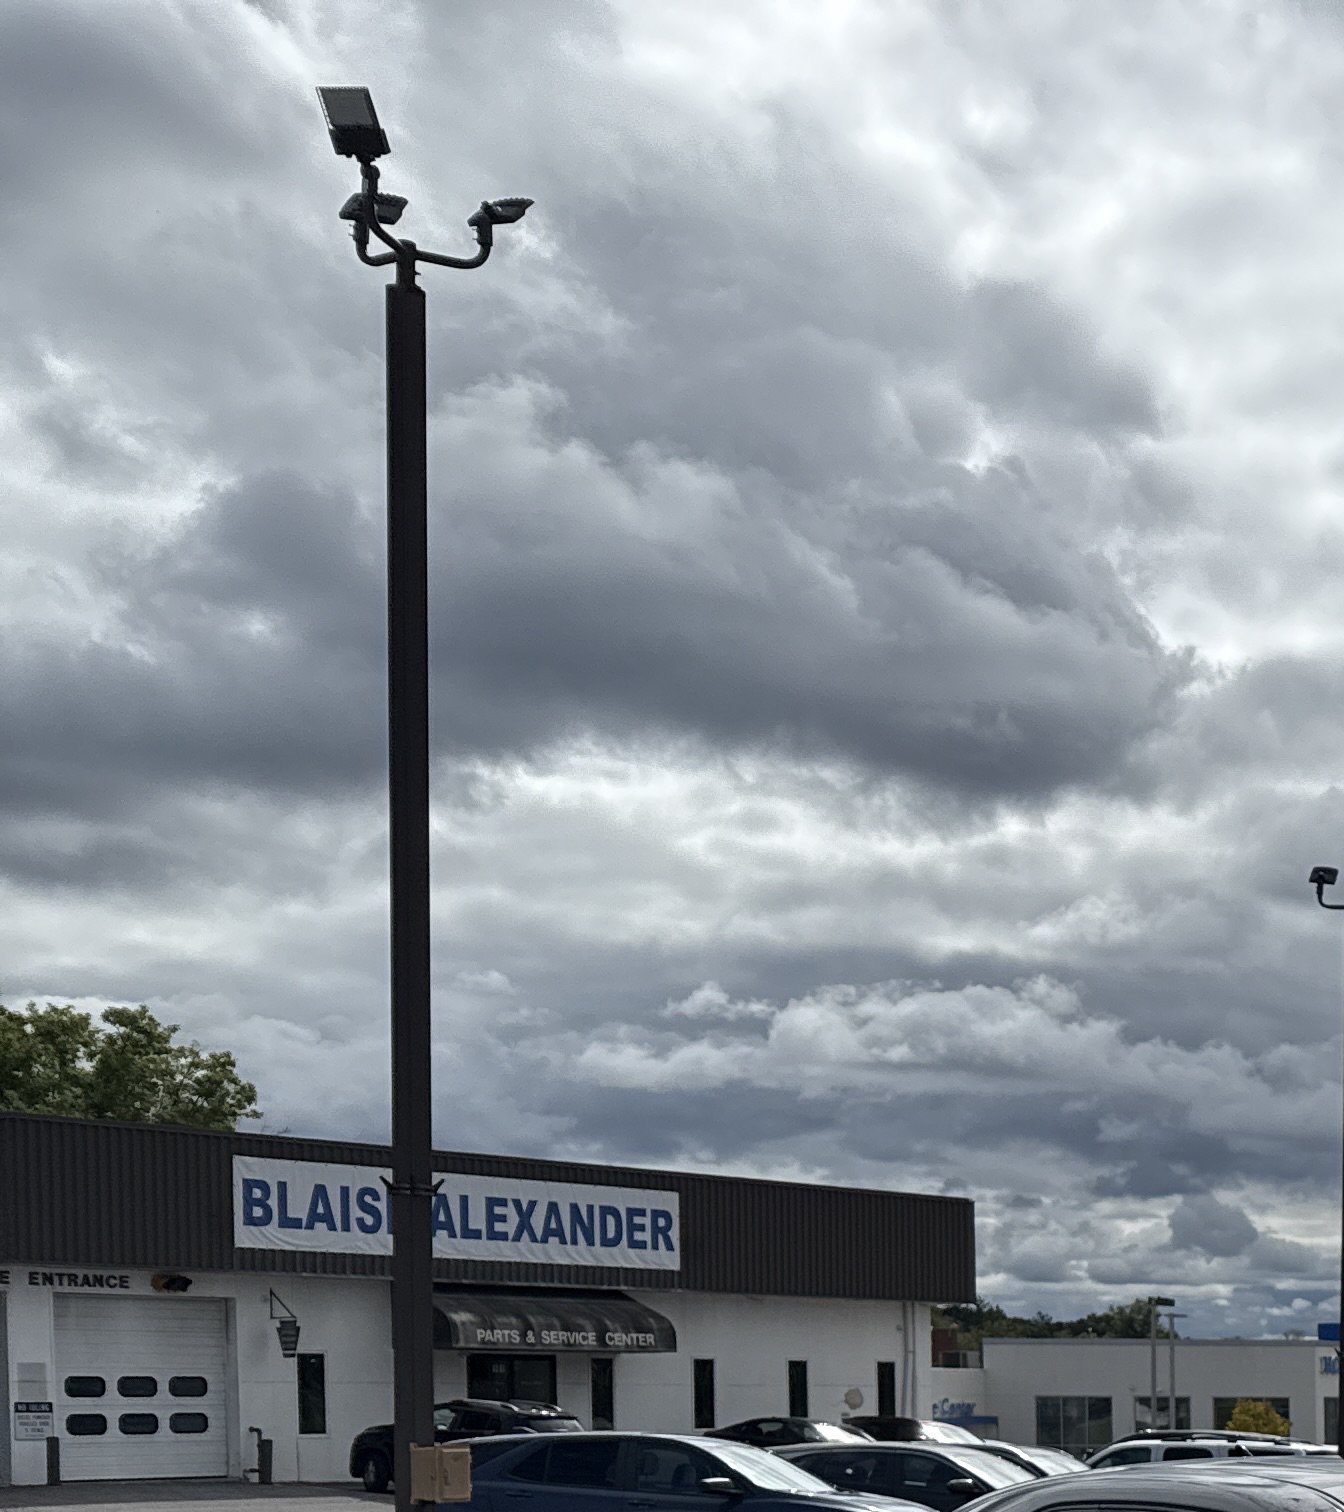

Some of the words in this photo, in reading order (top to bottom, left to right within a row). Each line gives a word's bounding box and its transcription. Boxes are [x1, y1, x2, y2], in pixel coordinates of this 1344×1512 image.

[241, 1177, 393, 1236] BLAIS
[432, 1192, 675, 1252] ALEXANDER
[28, 1271, 130, 1289] ENTRANCE
[476, 1328, 521, 1344] PARTS
[525, 1331, 536, 1344] &
[541, 1330, 597, 1345] SERVICE
[604, 1332, 655, 1346] CENTER
